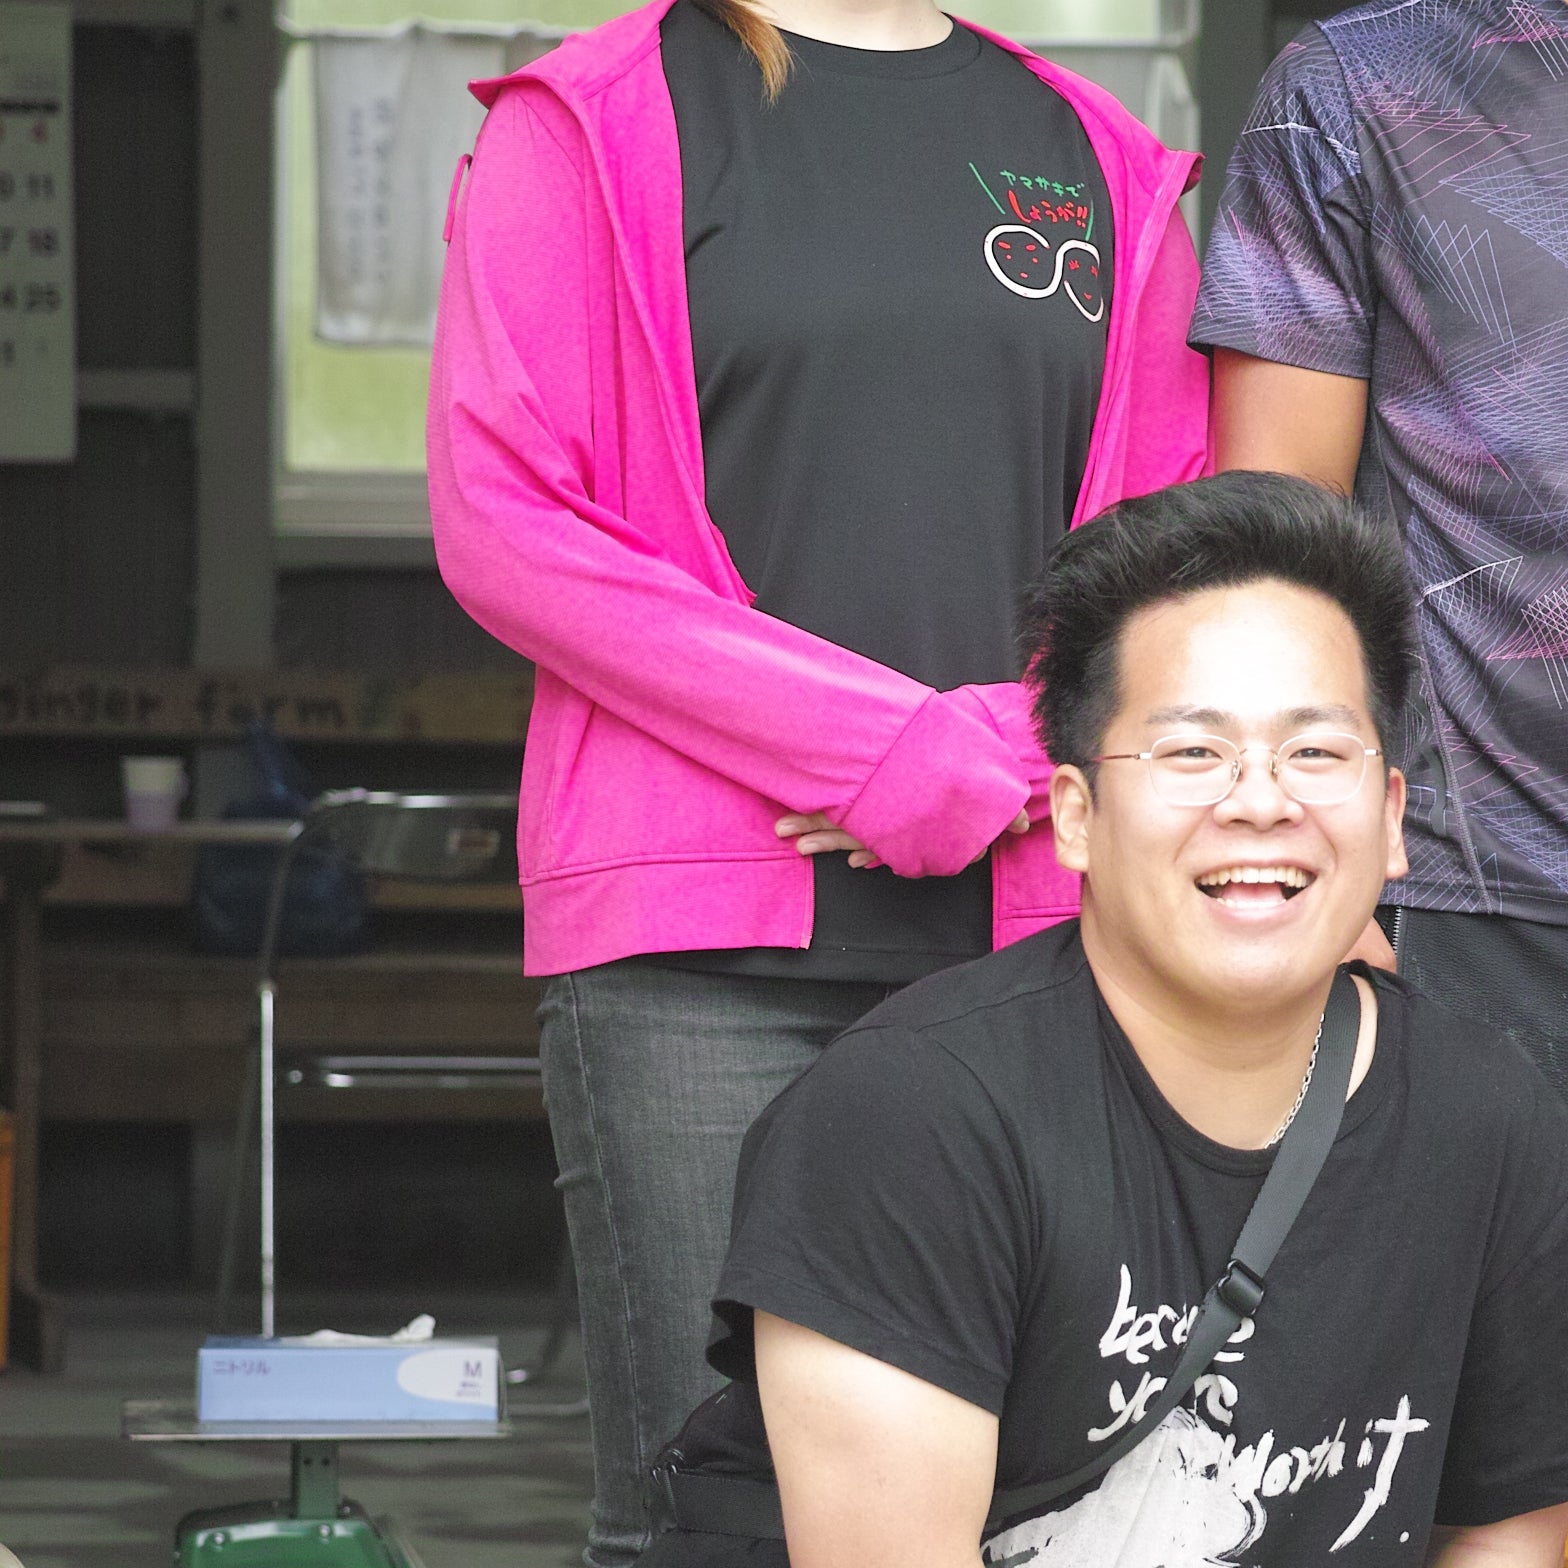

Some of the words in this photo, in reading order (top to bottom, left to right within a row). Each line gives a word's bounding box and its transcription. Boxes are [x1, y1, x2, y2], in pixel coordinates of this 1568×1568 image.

[213, 1359, 271, 1376] ニトリル
[463, 1360, 483, 1379] M
